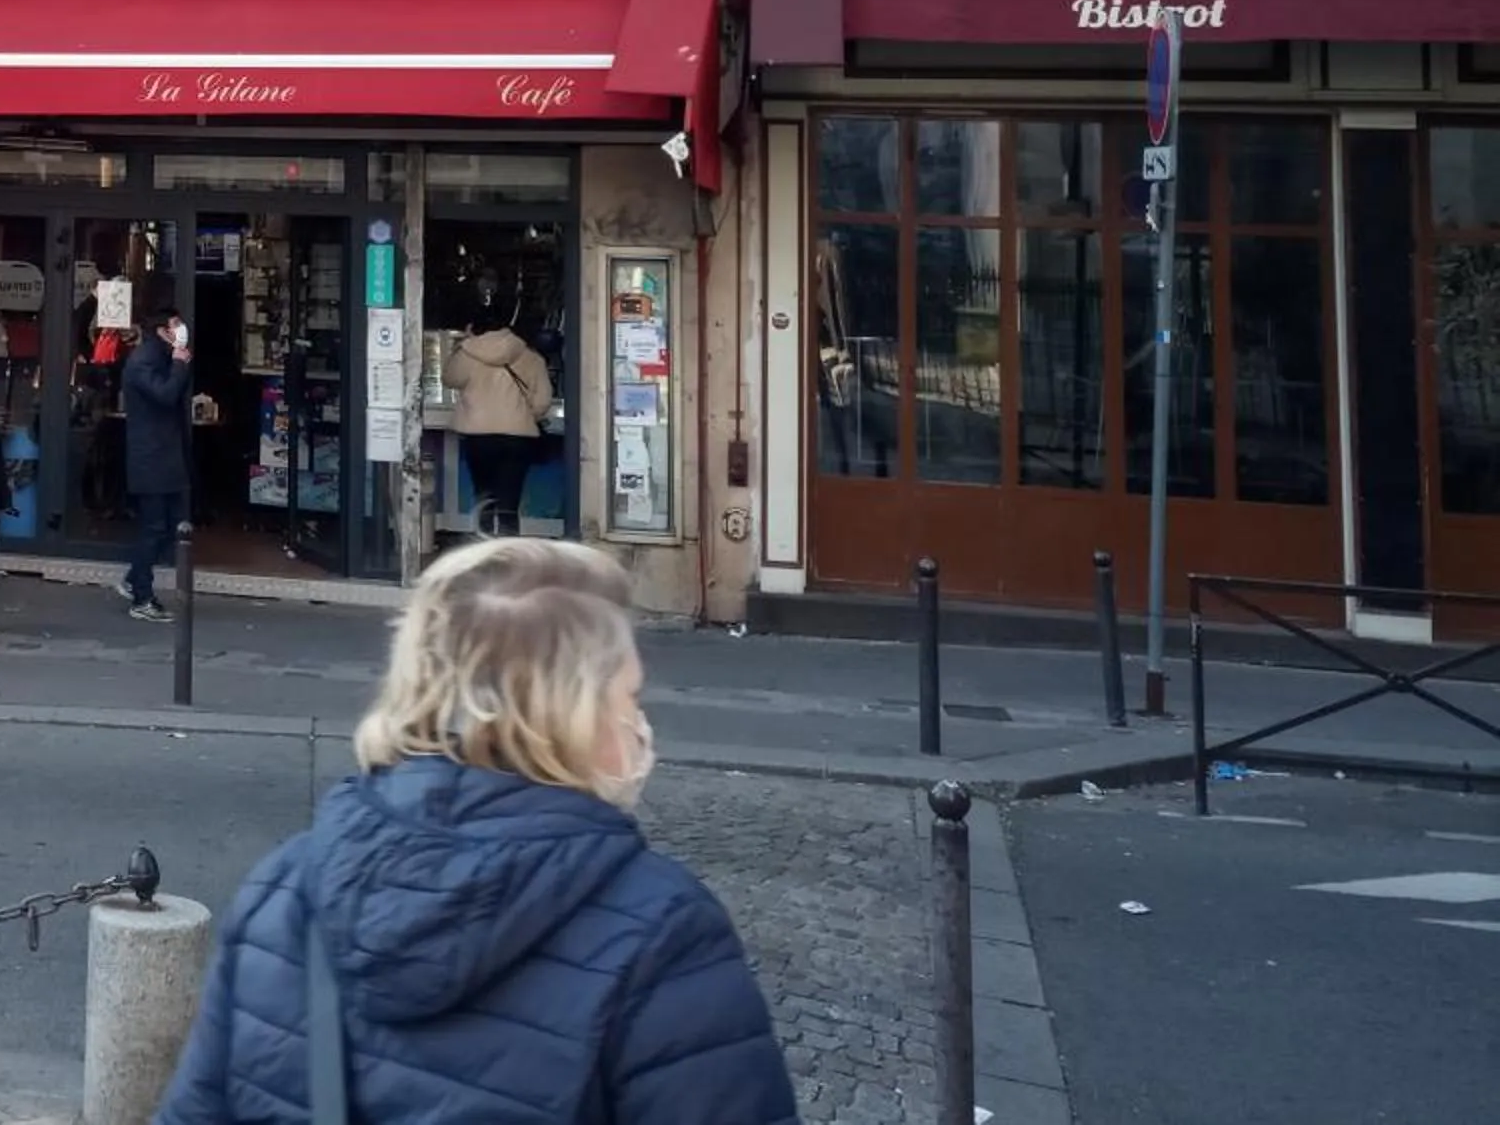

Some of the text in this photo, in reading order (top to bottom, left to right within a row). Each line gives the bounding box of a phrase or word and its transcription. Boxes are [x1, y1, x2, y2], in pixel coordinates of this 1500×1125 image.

[137, 74, 182, 103] La
[197, 72, 299, 103] Gitane
[496, 74, 575, 115] Café
